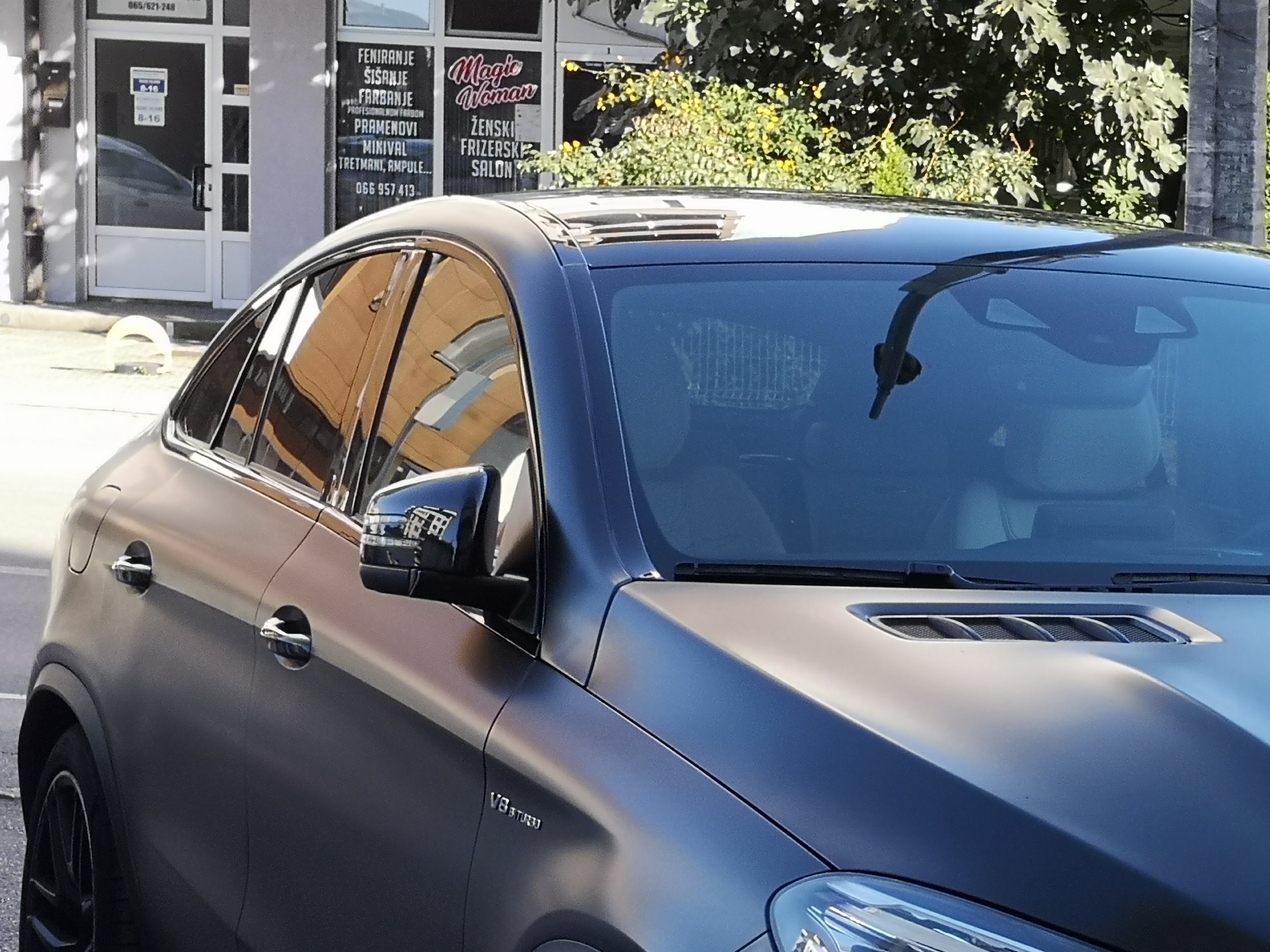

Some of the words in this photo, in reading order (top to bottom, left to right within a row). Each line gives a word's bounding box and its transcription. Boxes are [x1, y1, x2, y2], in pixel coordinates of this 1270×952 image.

[358, 48, 414, 66] FENIRANJE
[364, 66, 408, 86] ŠIŠANJE
[448, 54, 523, 87] Magic
[359, 89, 413, 107] FARBANJE
[455, 81, 538, 110] Woman
[138, 113, 160, 123] 8-16
[354, 118, 418, 136] PRAMENOVI
[471, 115, 515, 138] ŽENSKI
[363, 140, 407, 156] MINIVAL
[339, 157, 386, 173] TRETMANI,
[471, 160, 512, 179] SALON
[356, 182, 375, 195] 066
[378, 183, 396, 196] 957
[398, 184, 415, 197] 413
